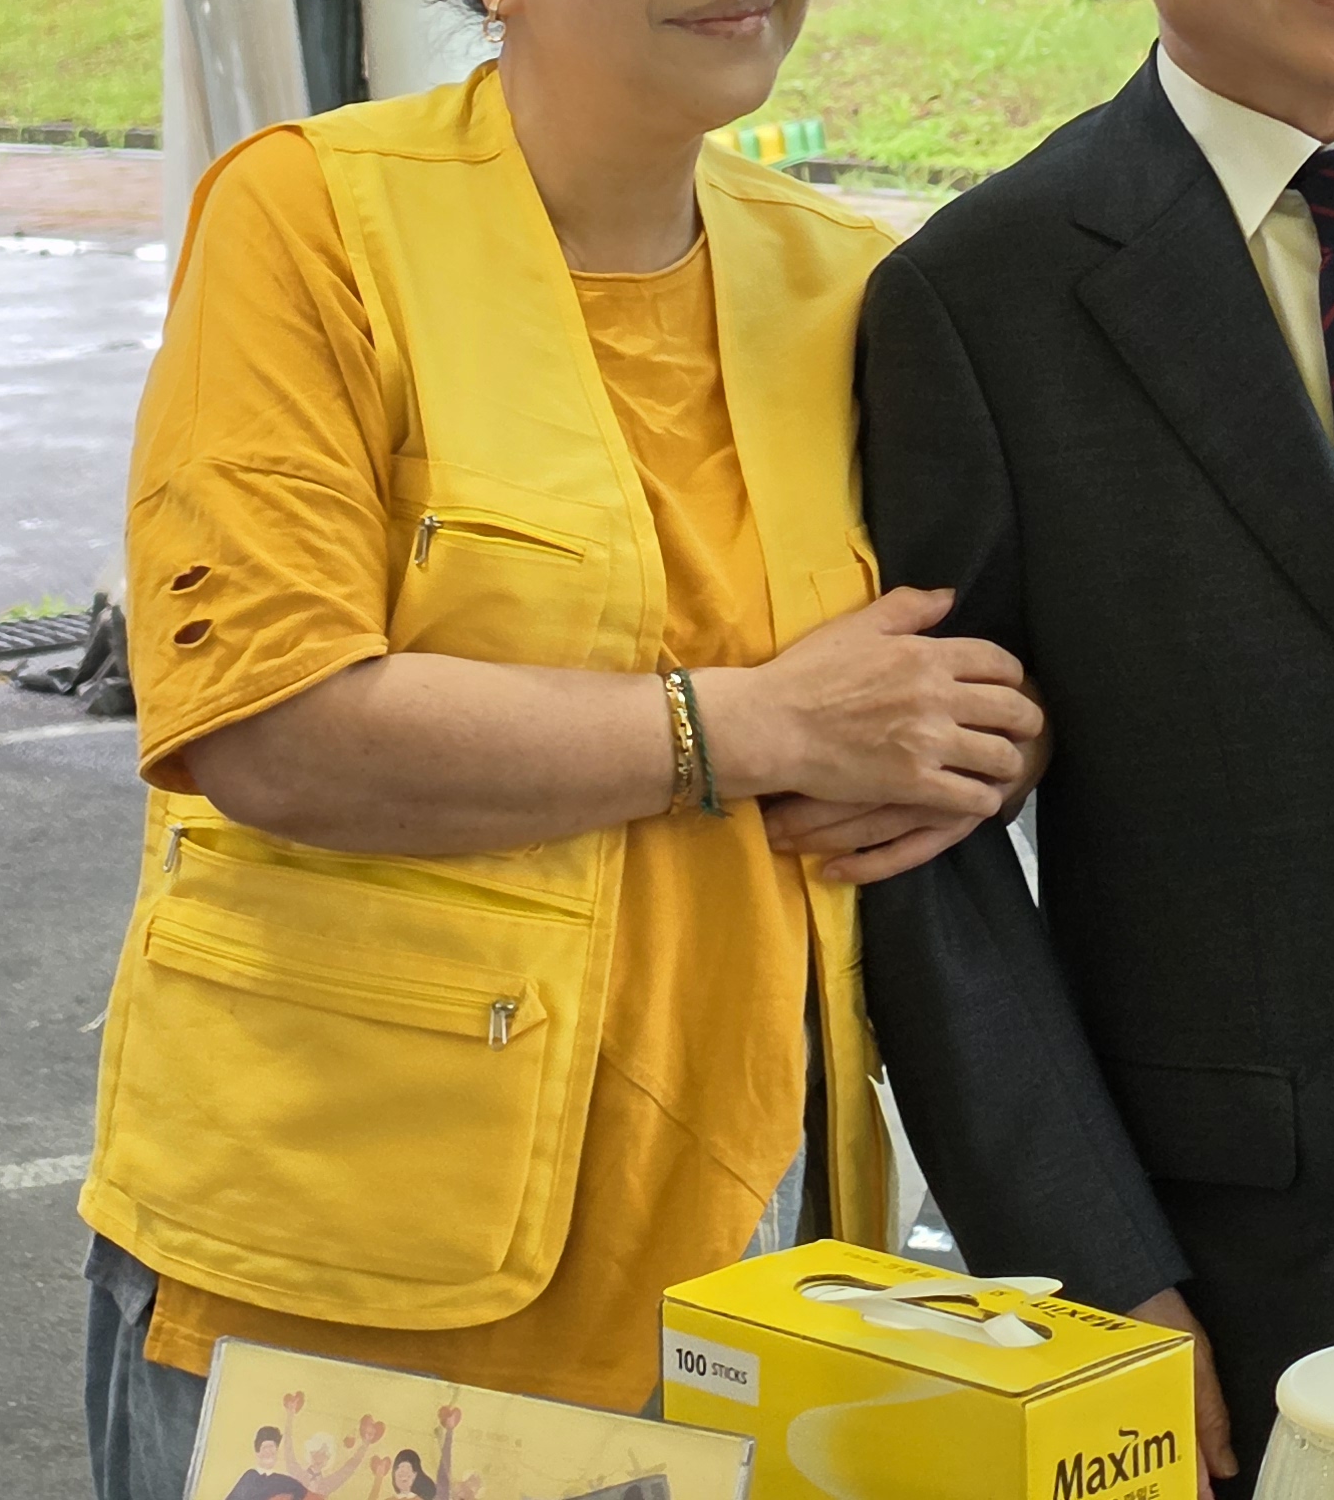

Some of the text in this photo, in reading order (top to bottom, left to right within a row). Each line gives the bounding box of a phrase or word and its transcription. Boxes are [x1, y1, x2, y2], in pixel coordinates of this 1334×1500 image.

[675, 1347, 748, 1386] 100 STICKS
[1052, 1428, 1176, 1500] Maxim
